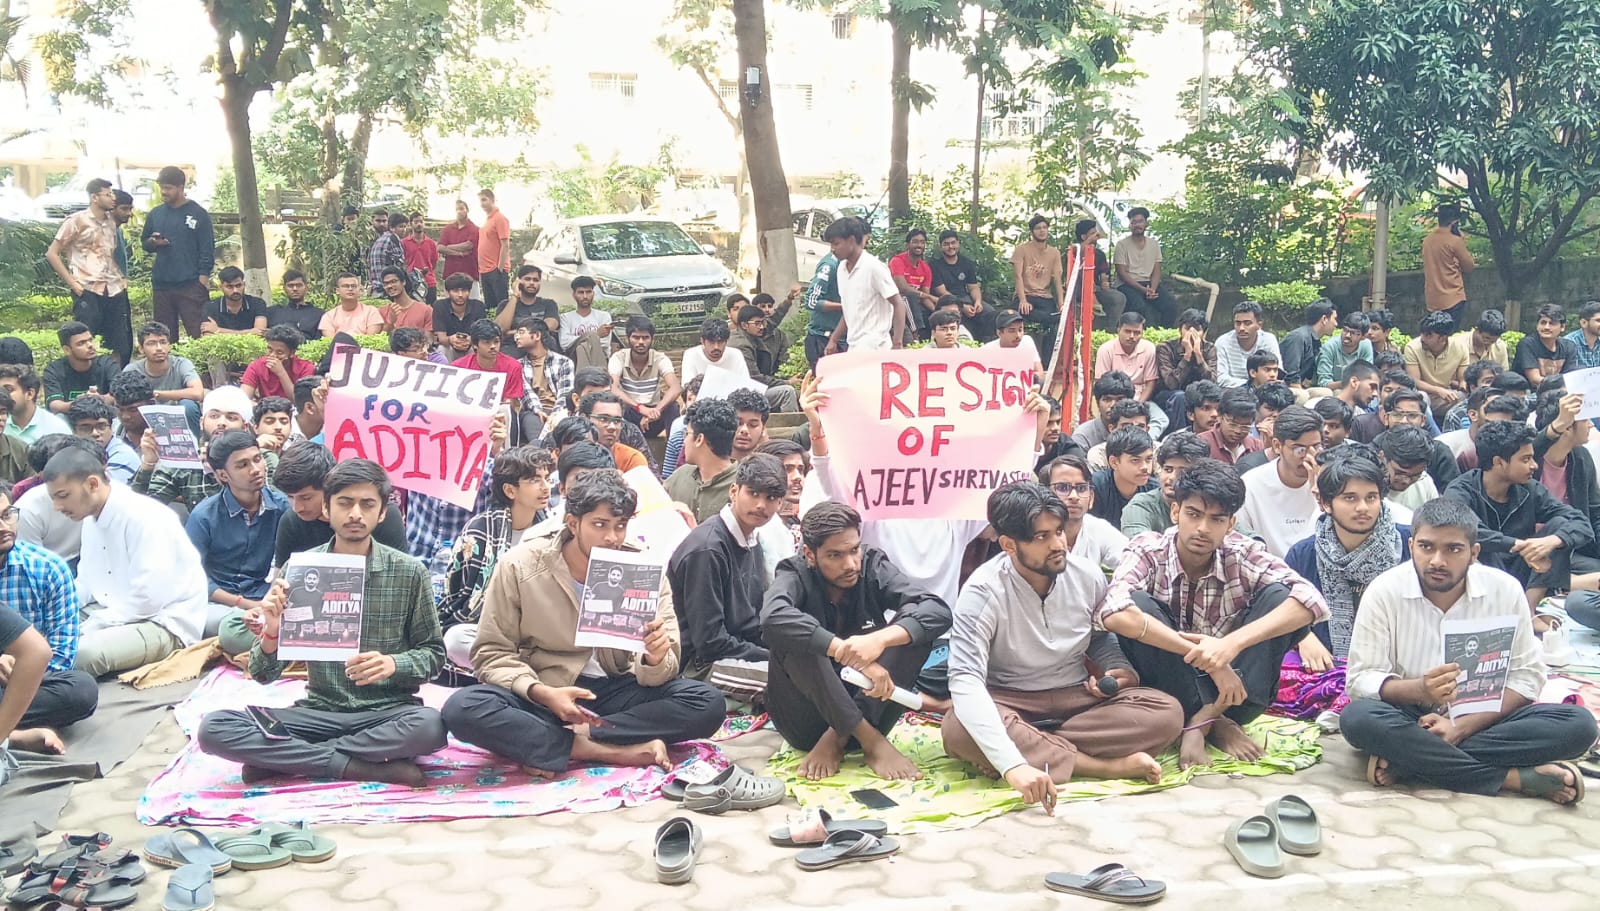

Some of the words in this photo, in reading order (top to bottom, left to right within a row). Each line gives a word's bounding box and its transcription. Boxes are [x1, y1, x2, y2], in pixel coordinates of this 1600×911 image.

[330, 345, 499, 410] JUSTICE
[880, 361, 1035, 420] RESIGN
[363, 394, 431, 425] FOR
[333, 418, 488, 492] ADITYA
[897, 424, 955, 457] OF
[853, 467, 938, 510] AJEEV
[321, 600, 360, 614] ADITYA
[621, 597, 657, 612] ADITYA
[1474, 657, 1509, 674] ADITYA
